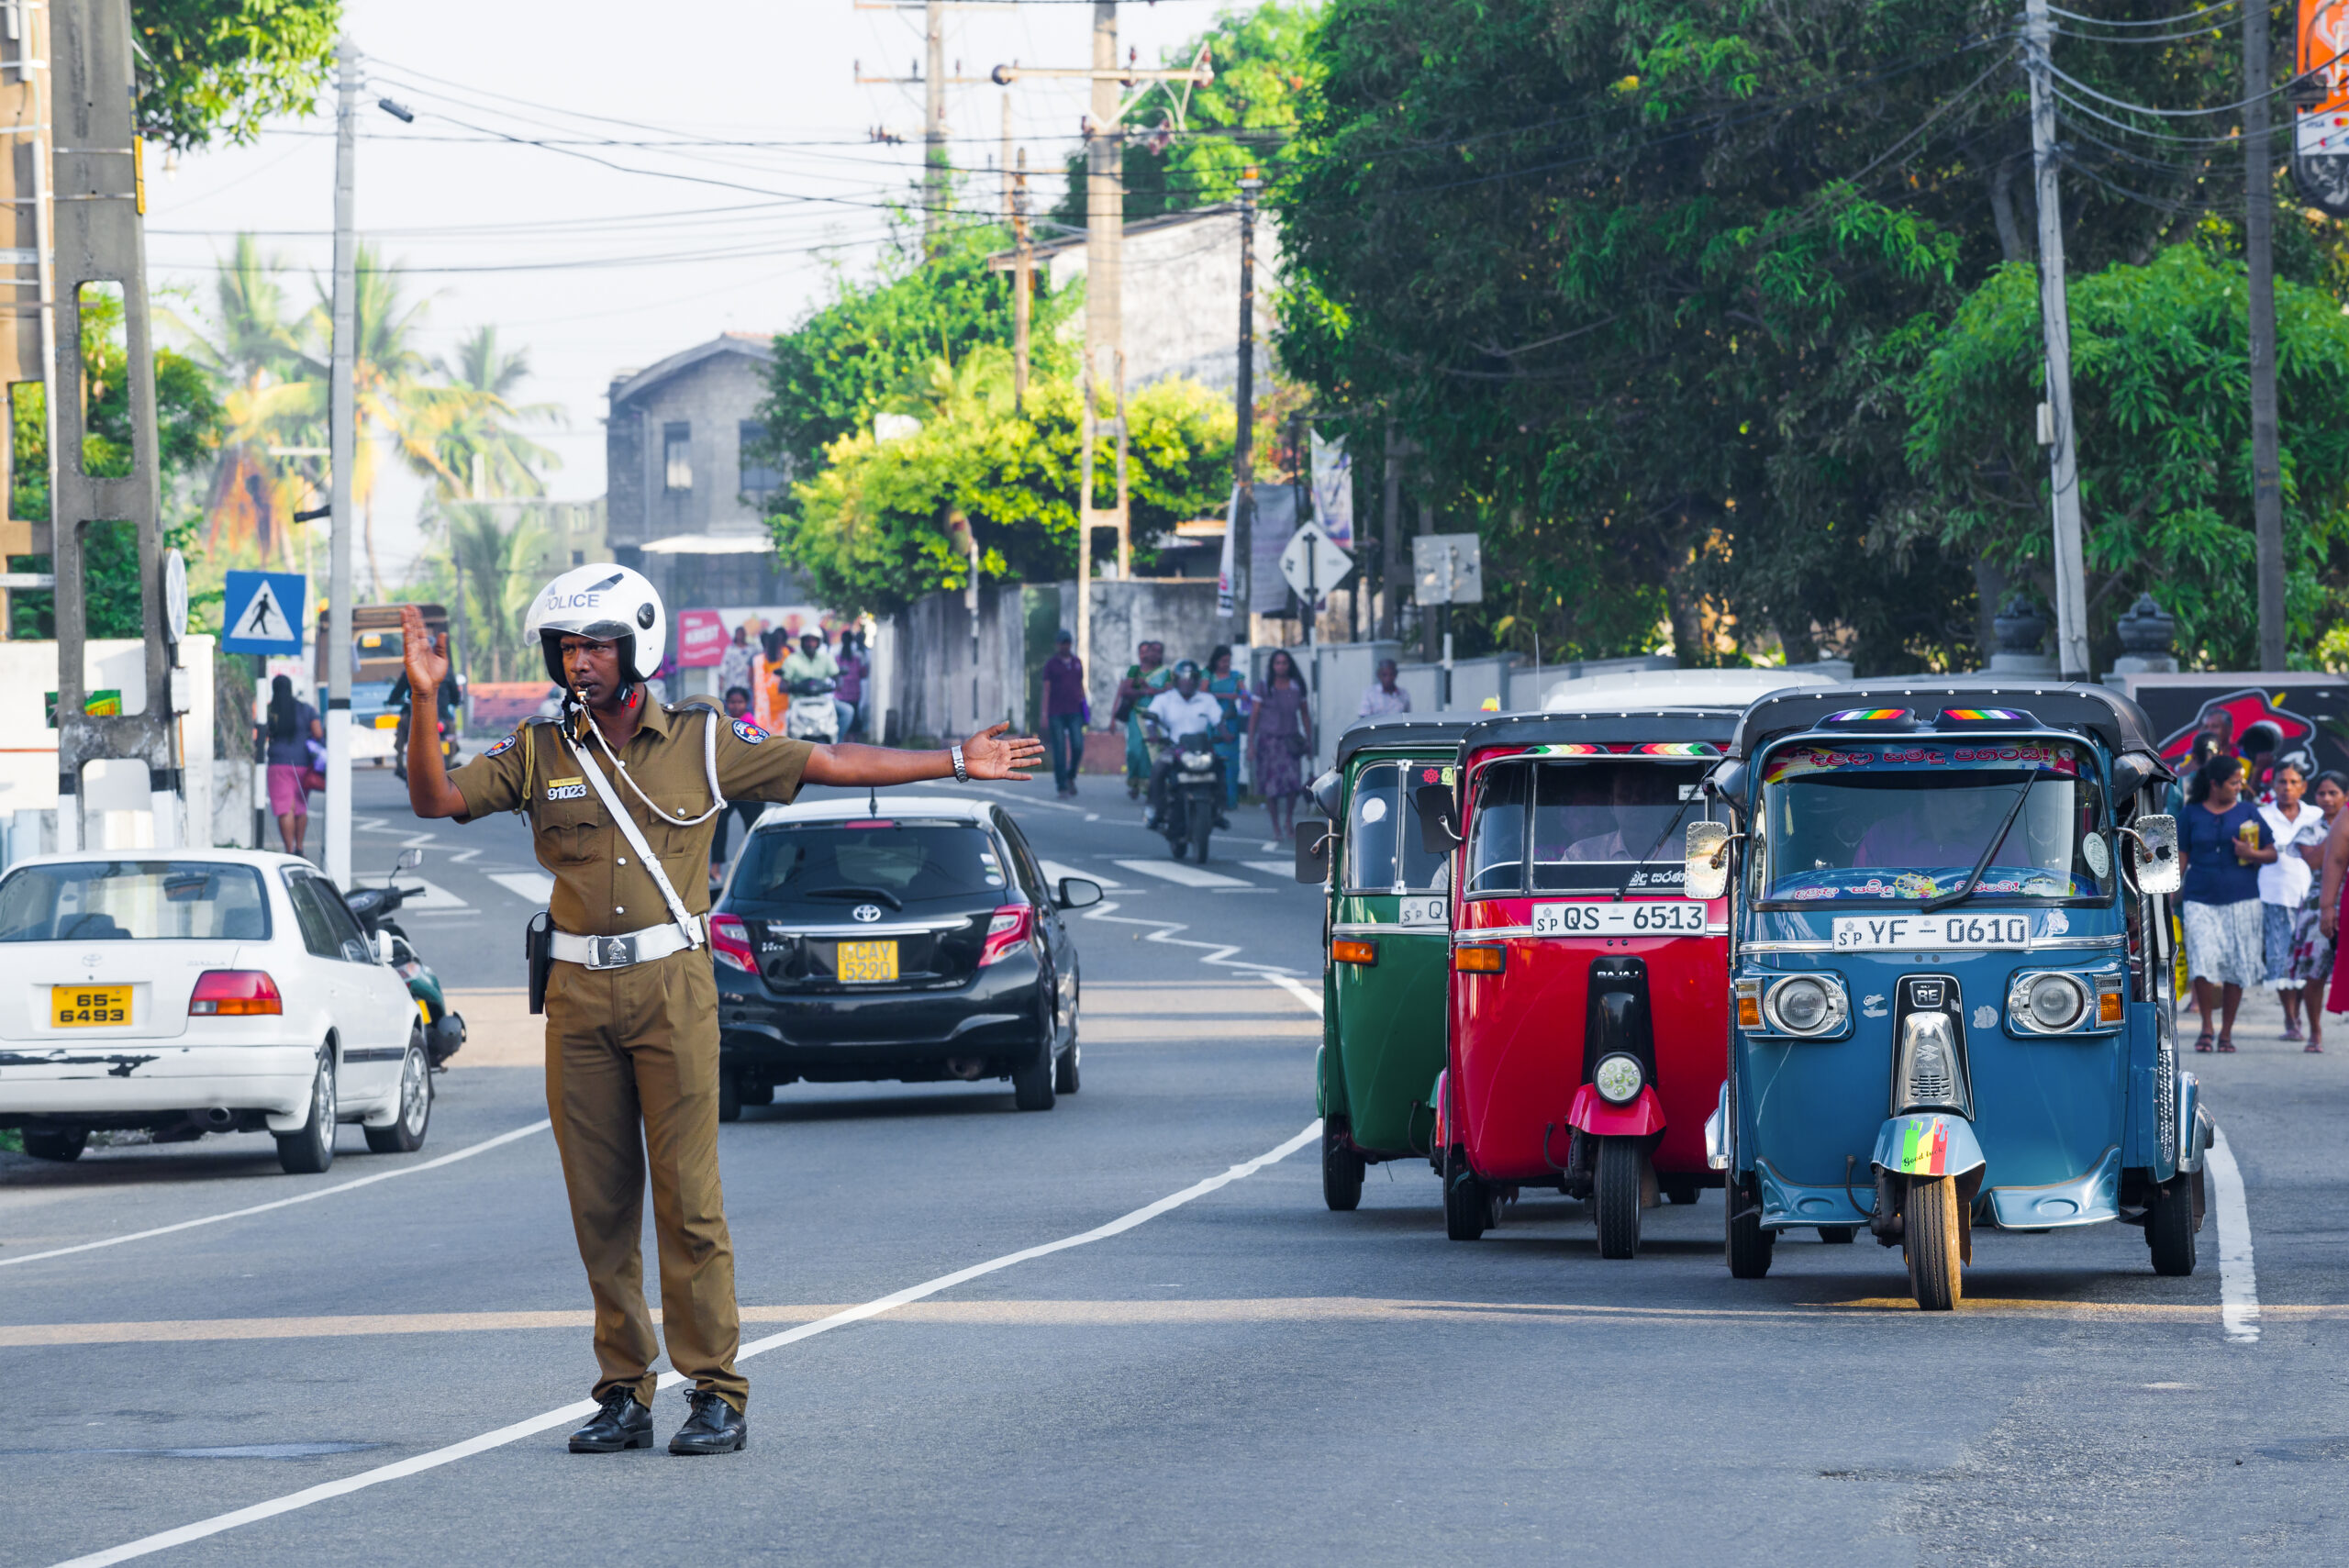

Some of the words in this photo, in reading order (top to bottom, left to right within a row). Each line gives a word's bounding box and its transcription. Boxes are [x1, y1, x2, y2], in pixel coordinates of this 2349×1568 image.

[546, 594, 600, 611] OLICE
[547, 784, 587, 801] 91023
[1564, 906, 1600, 930] QS
[1632, 906, 1702, 929] 6513
[1869, 919, 1909, 944] YF
[1946, 918, 2026, 943] 0610
[856, 942, 890, 960] CAY
[846, 962, 890, 980] 5290
[1917, 989, 1939, 1002] RE
[60, 1008, 124, 1022] 6493
